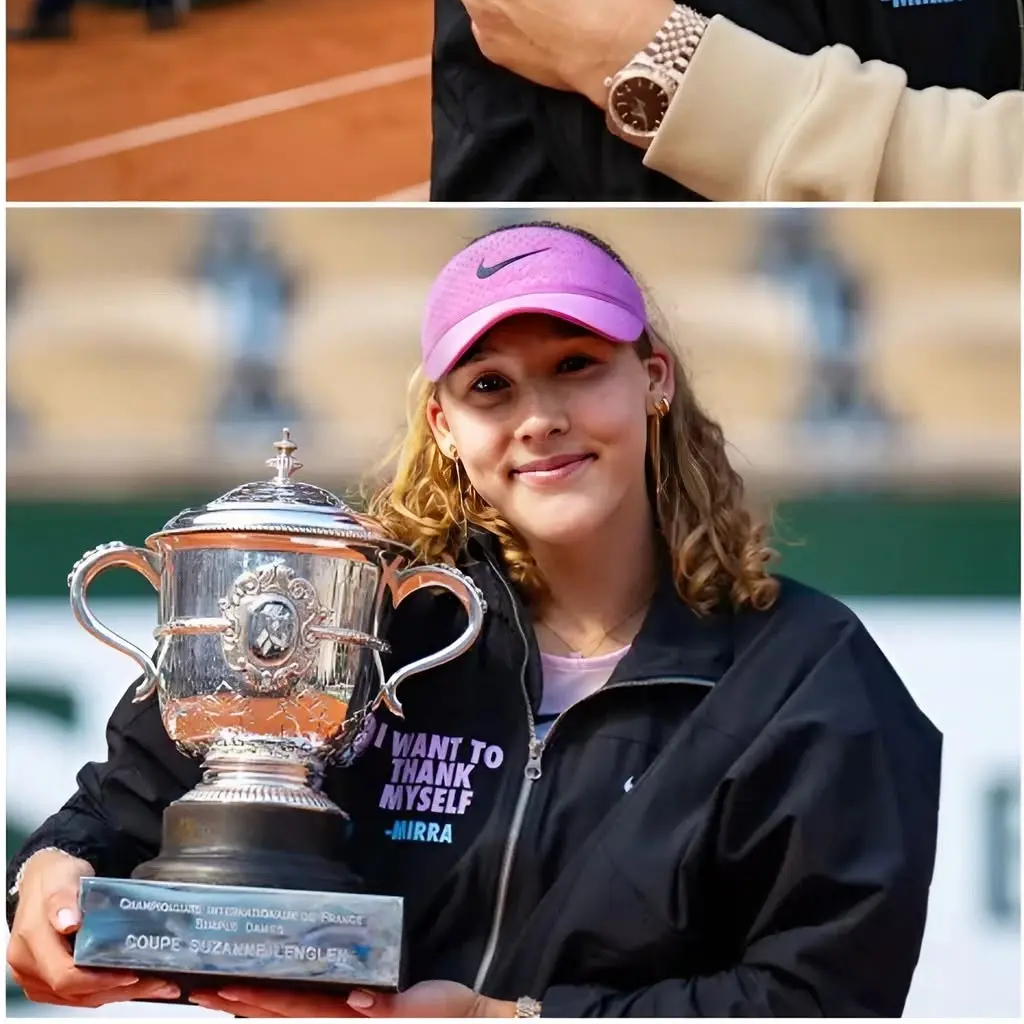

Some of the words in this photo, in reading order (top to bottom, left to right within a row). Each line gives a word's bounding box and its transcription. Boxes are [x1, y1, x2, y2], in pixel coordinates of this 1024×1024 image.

[374, 722, 388, 749] I
[391, 730, 464, 762] WANT
[470, 739, 504, 769] TO
[390, 758, 475, 788] THANK
[378, 783, 474, 814] MYSELF
[125, 934, 180, 952] COUPE
